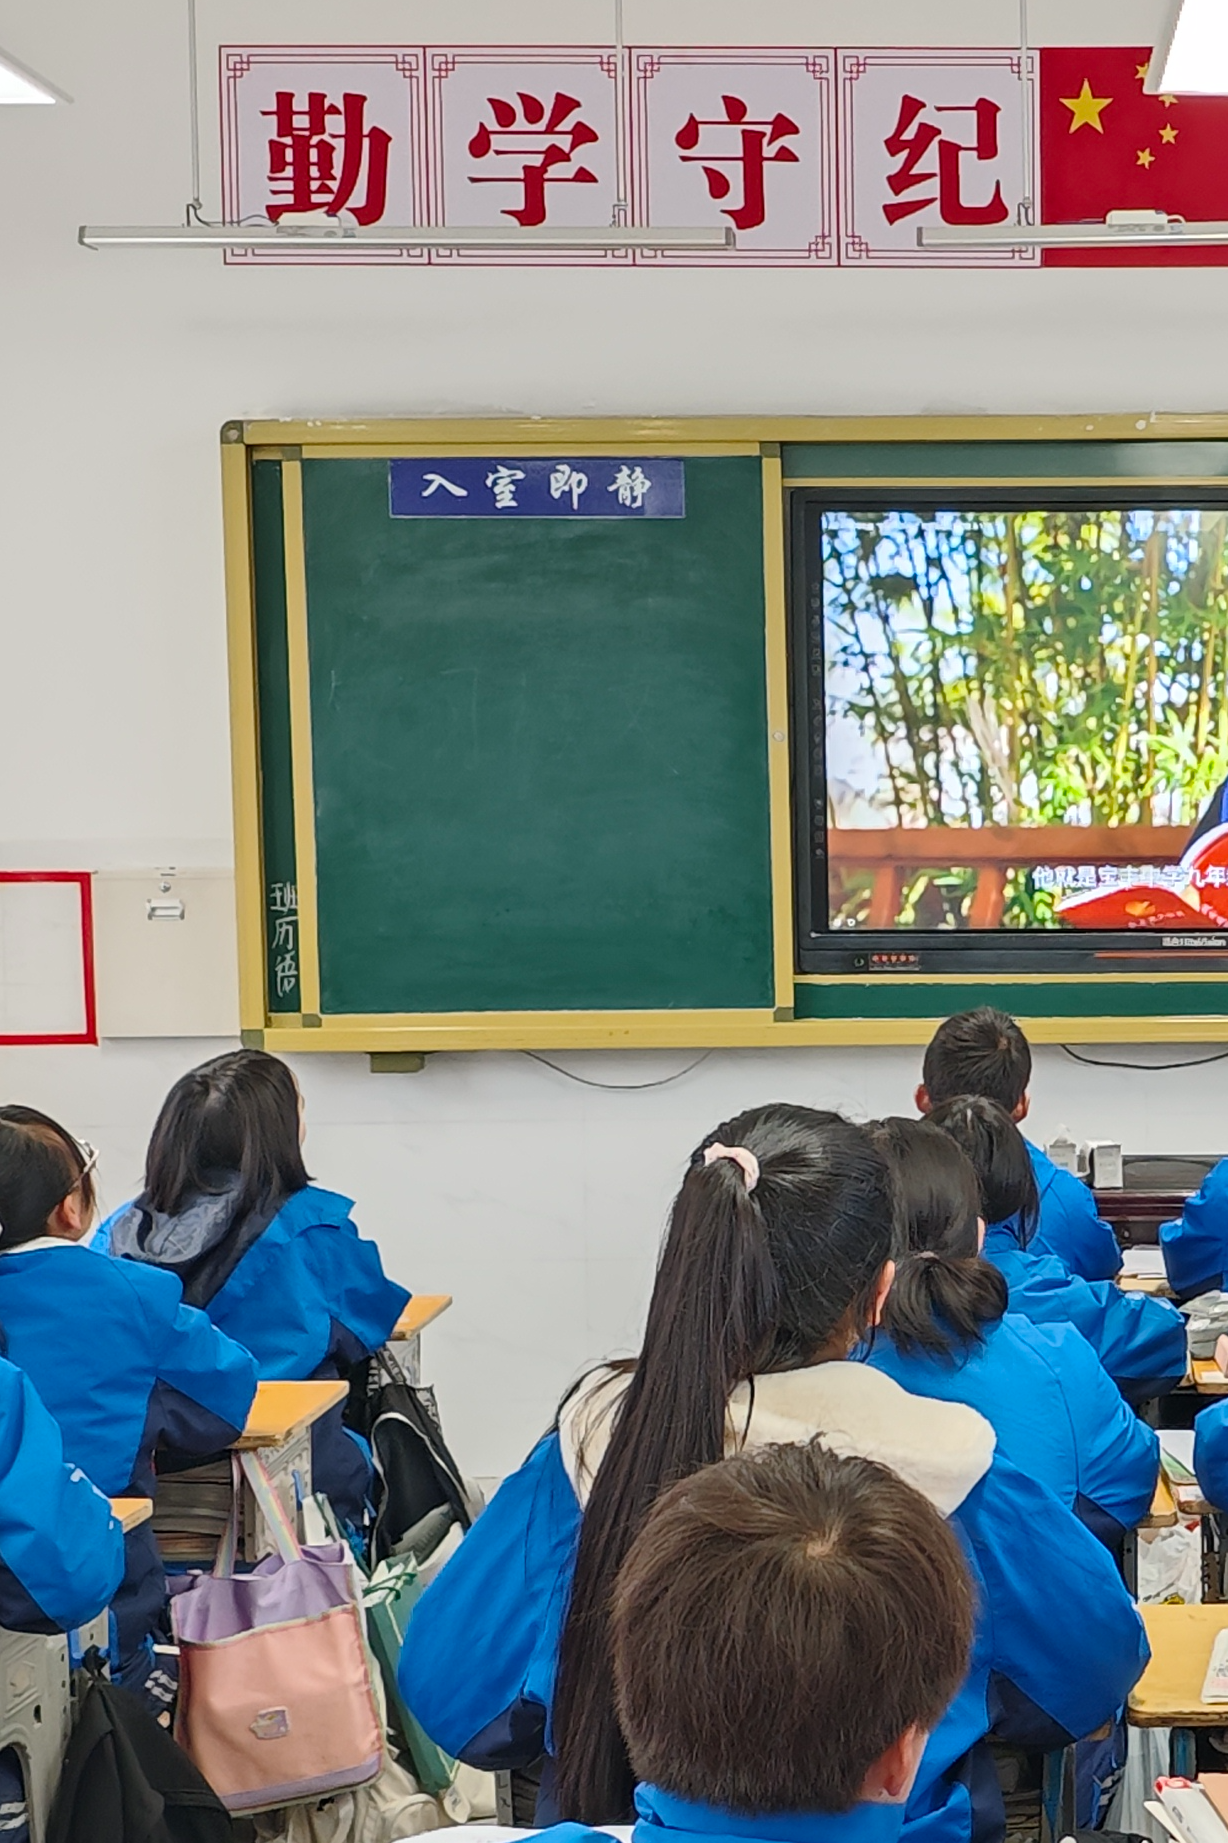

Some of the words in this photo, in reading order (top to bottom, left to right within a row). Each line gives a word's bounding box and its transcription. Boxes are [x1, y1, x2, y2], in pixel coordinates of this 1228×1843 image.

[260, 91, 1008, 227] 勤学守纪
[421, 465, 652, 509] 入室即静
